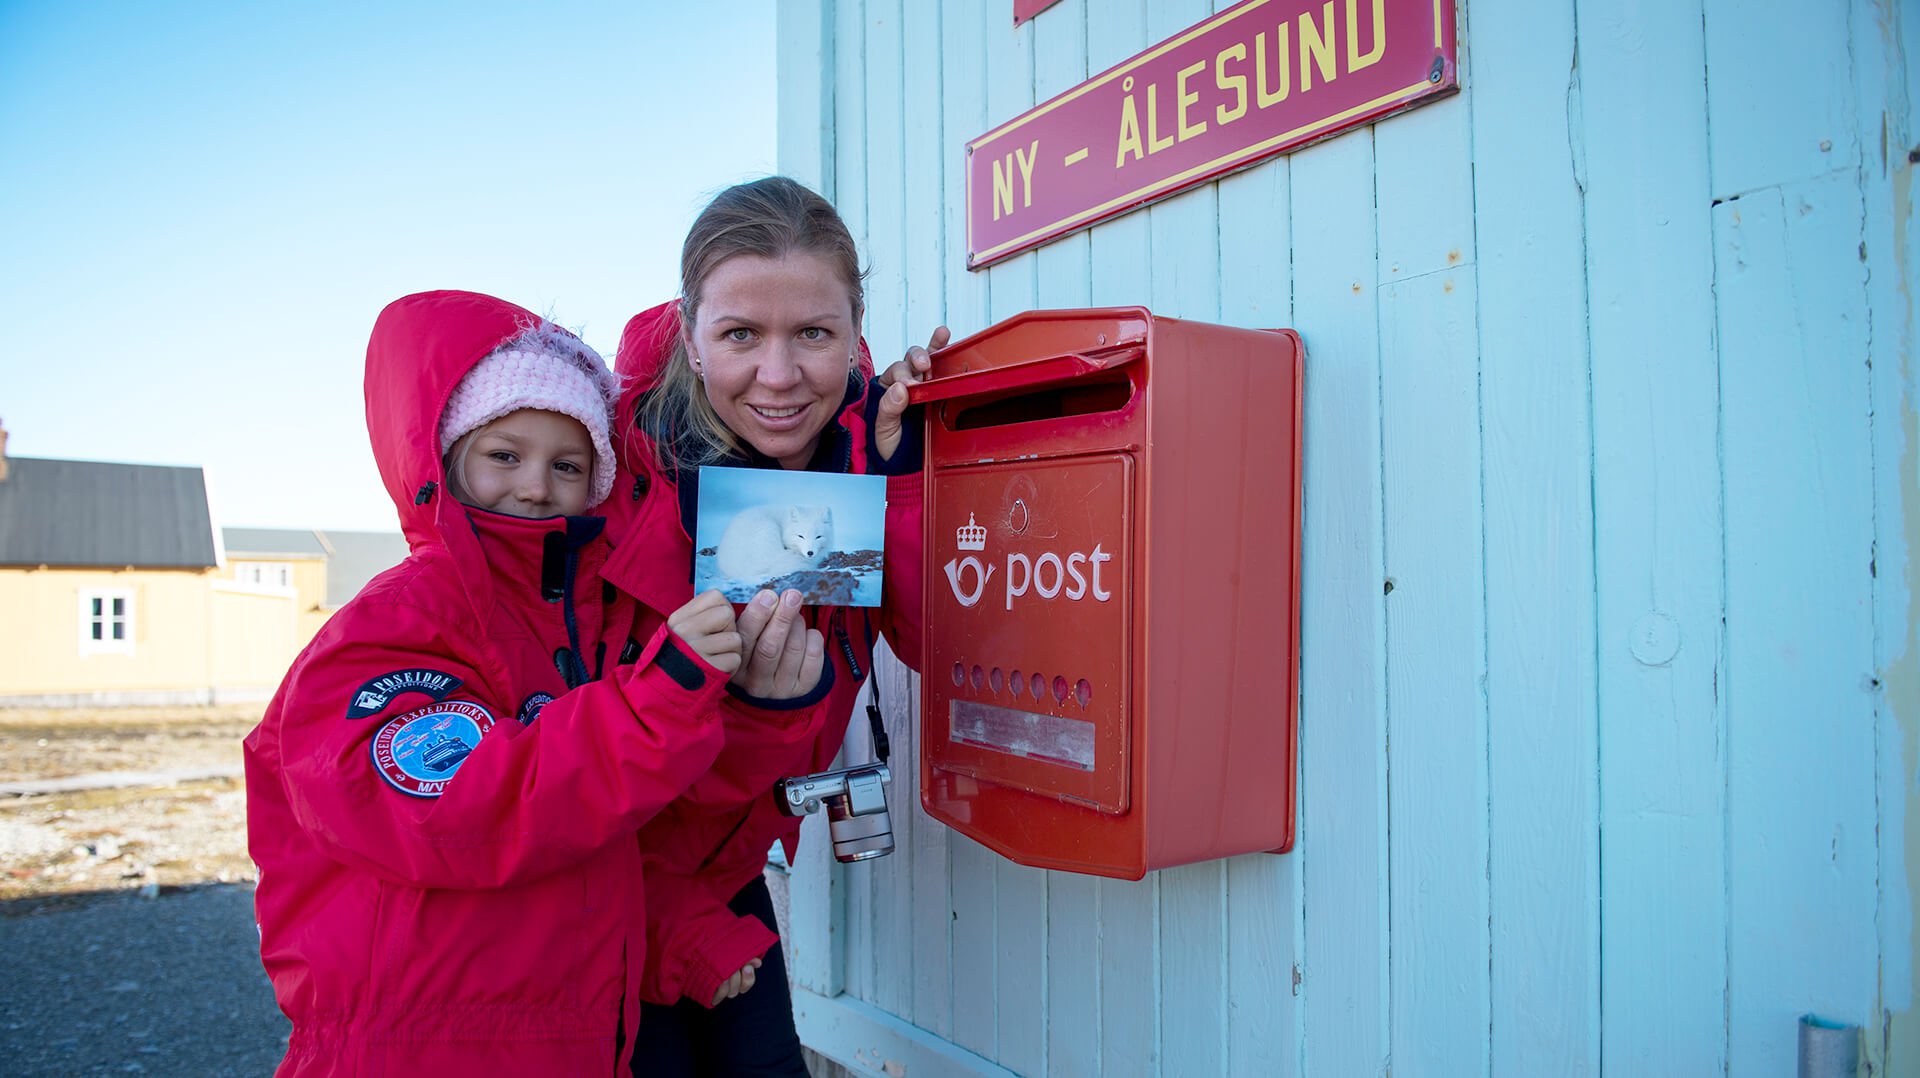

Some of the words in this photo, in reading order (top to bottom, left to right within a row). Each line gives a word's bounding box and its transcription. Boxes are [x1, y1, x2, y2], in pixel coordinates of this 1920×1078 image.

[992, 140, 1039, 221] NY
[1115, 0, 1387, 168] ÅLESUND
[1006, 543, 1111, 610] post
[373, 671, 452, 691] POSEIDON
[377, 722, 402, 769] POSEIDON
[401, 703, 484, 722] EXPEDITIONS
